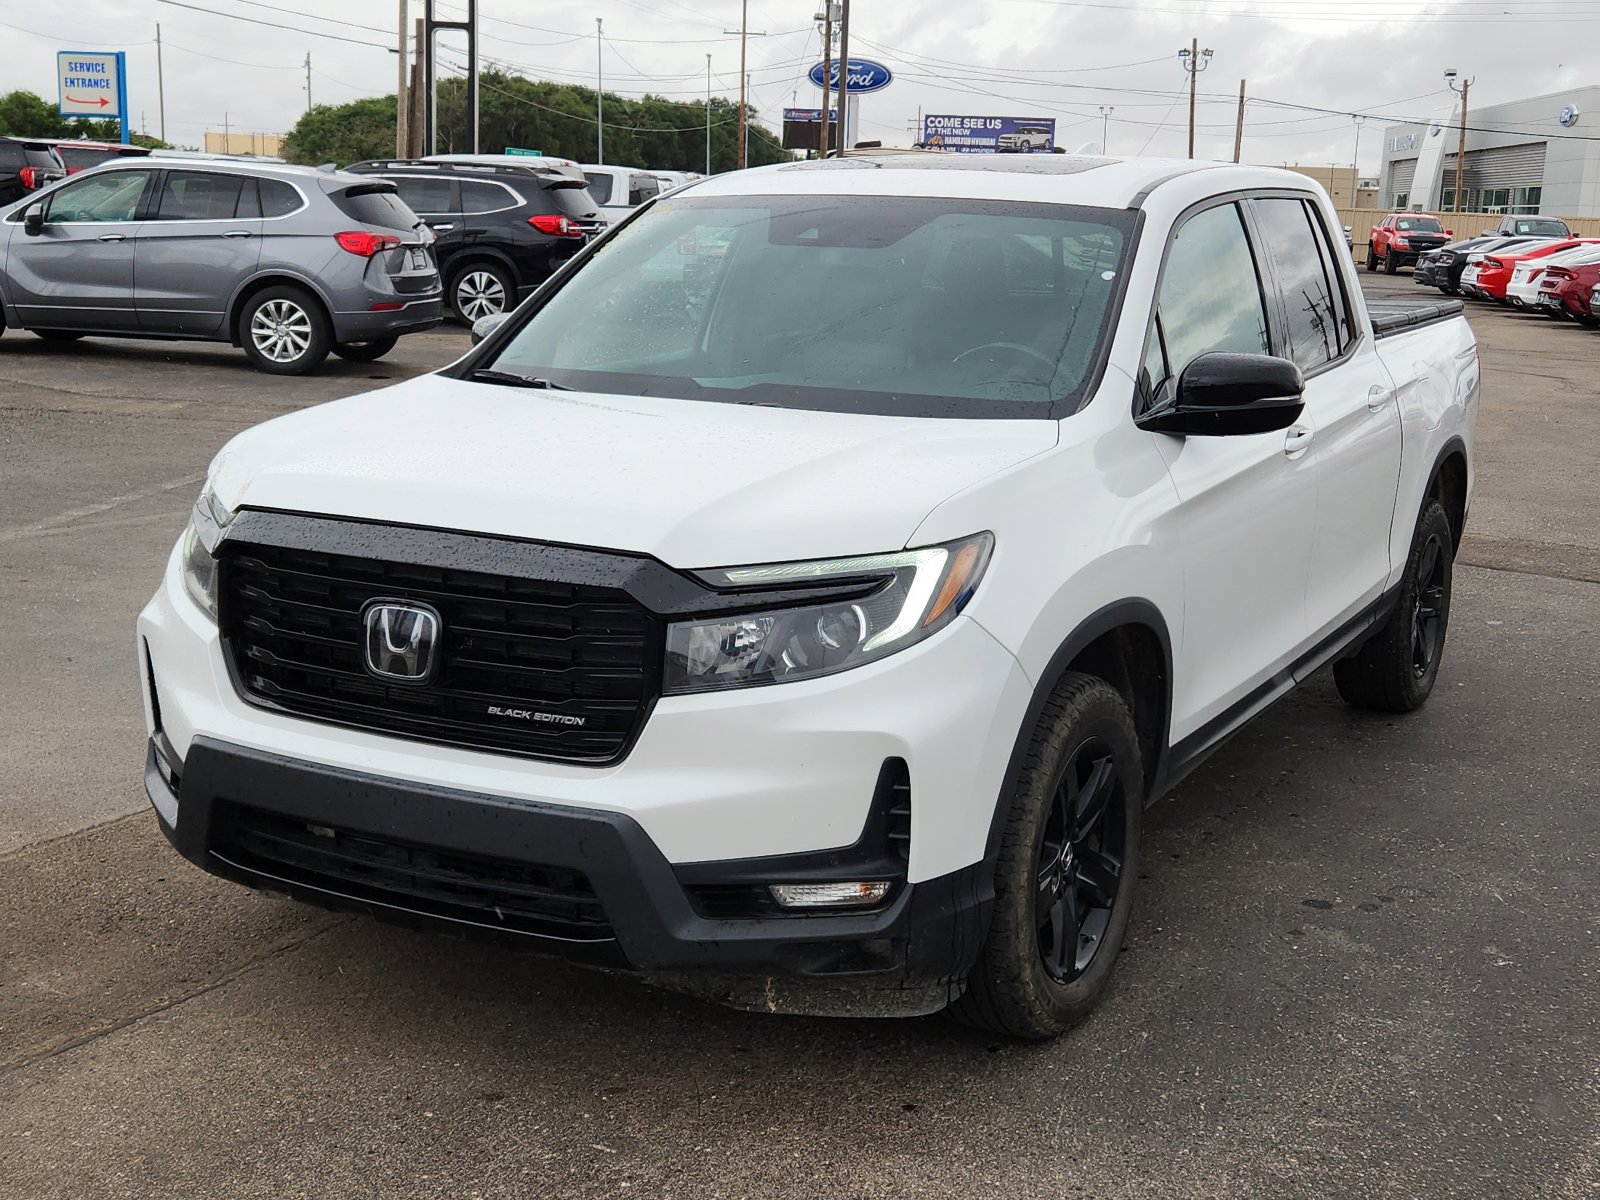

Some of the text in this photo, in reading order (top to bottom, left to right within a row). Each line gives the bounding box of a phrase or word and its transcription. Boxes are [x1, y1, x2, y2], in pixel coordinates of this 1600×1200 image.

[68, 61, 106, 73] SERVICE
[823, 63, 875, 86] Frd
[64, 77, 110, 89] ENTRANCE
[927, 117, 1002, 130] COME SEE US
[952, 128, 971, 136] NEW
[487, 706, 586, 726] BLACK EDITION
